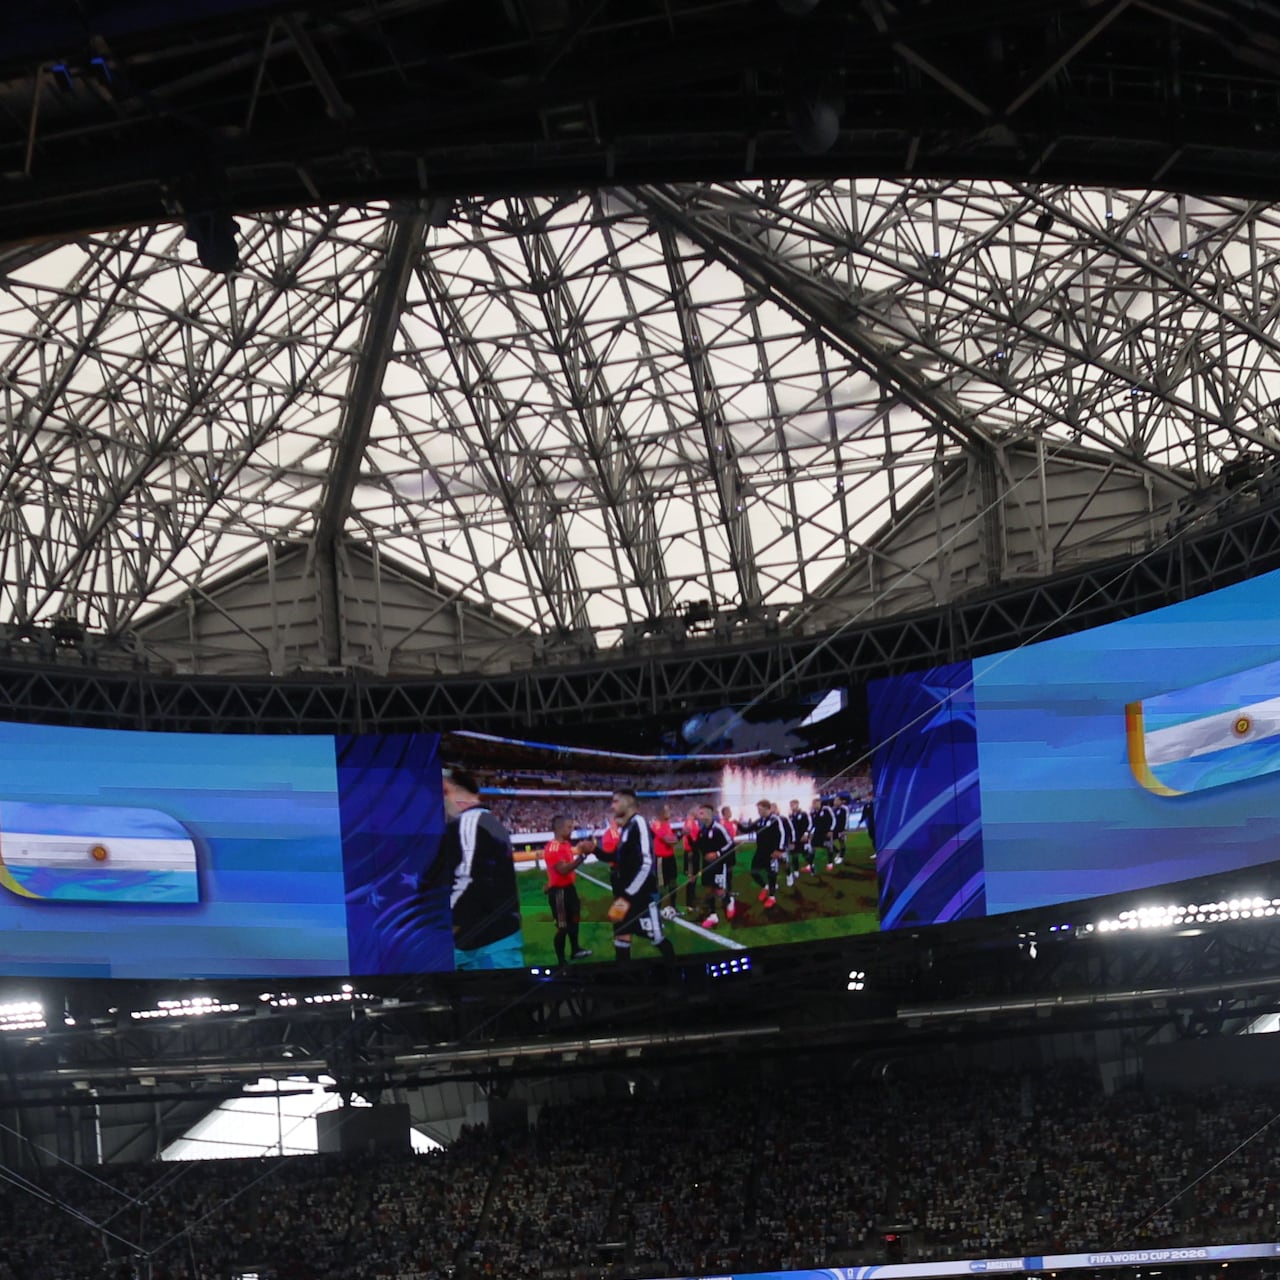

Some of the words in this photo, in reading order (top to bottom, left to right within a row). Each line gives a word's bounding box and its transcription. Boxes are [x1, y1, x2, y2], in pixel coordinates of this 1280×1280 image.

[1090, 1255, 1111, 1265] FIFA
[1111, 1253, 1150, 1263] WORLD
[1150, 1251, 1170, 1261] CUP
[1171, 1249, 1207, 1259] 2026
[986, 1260, 1023, 1271] ARGENTINA
